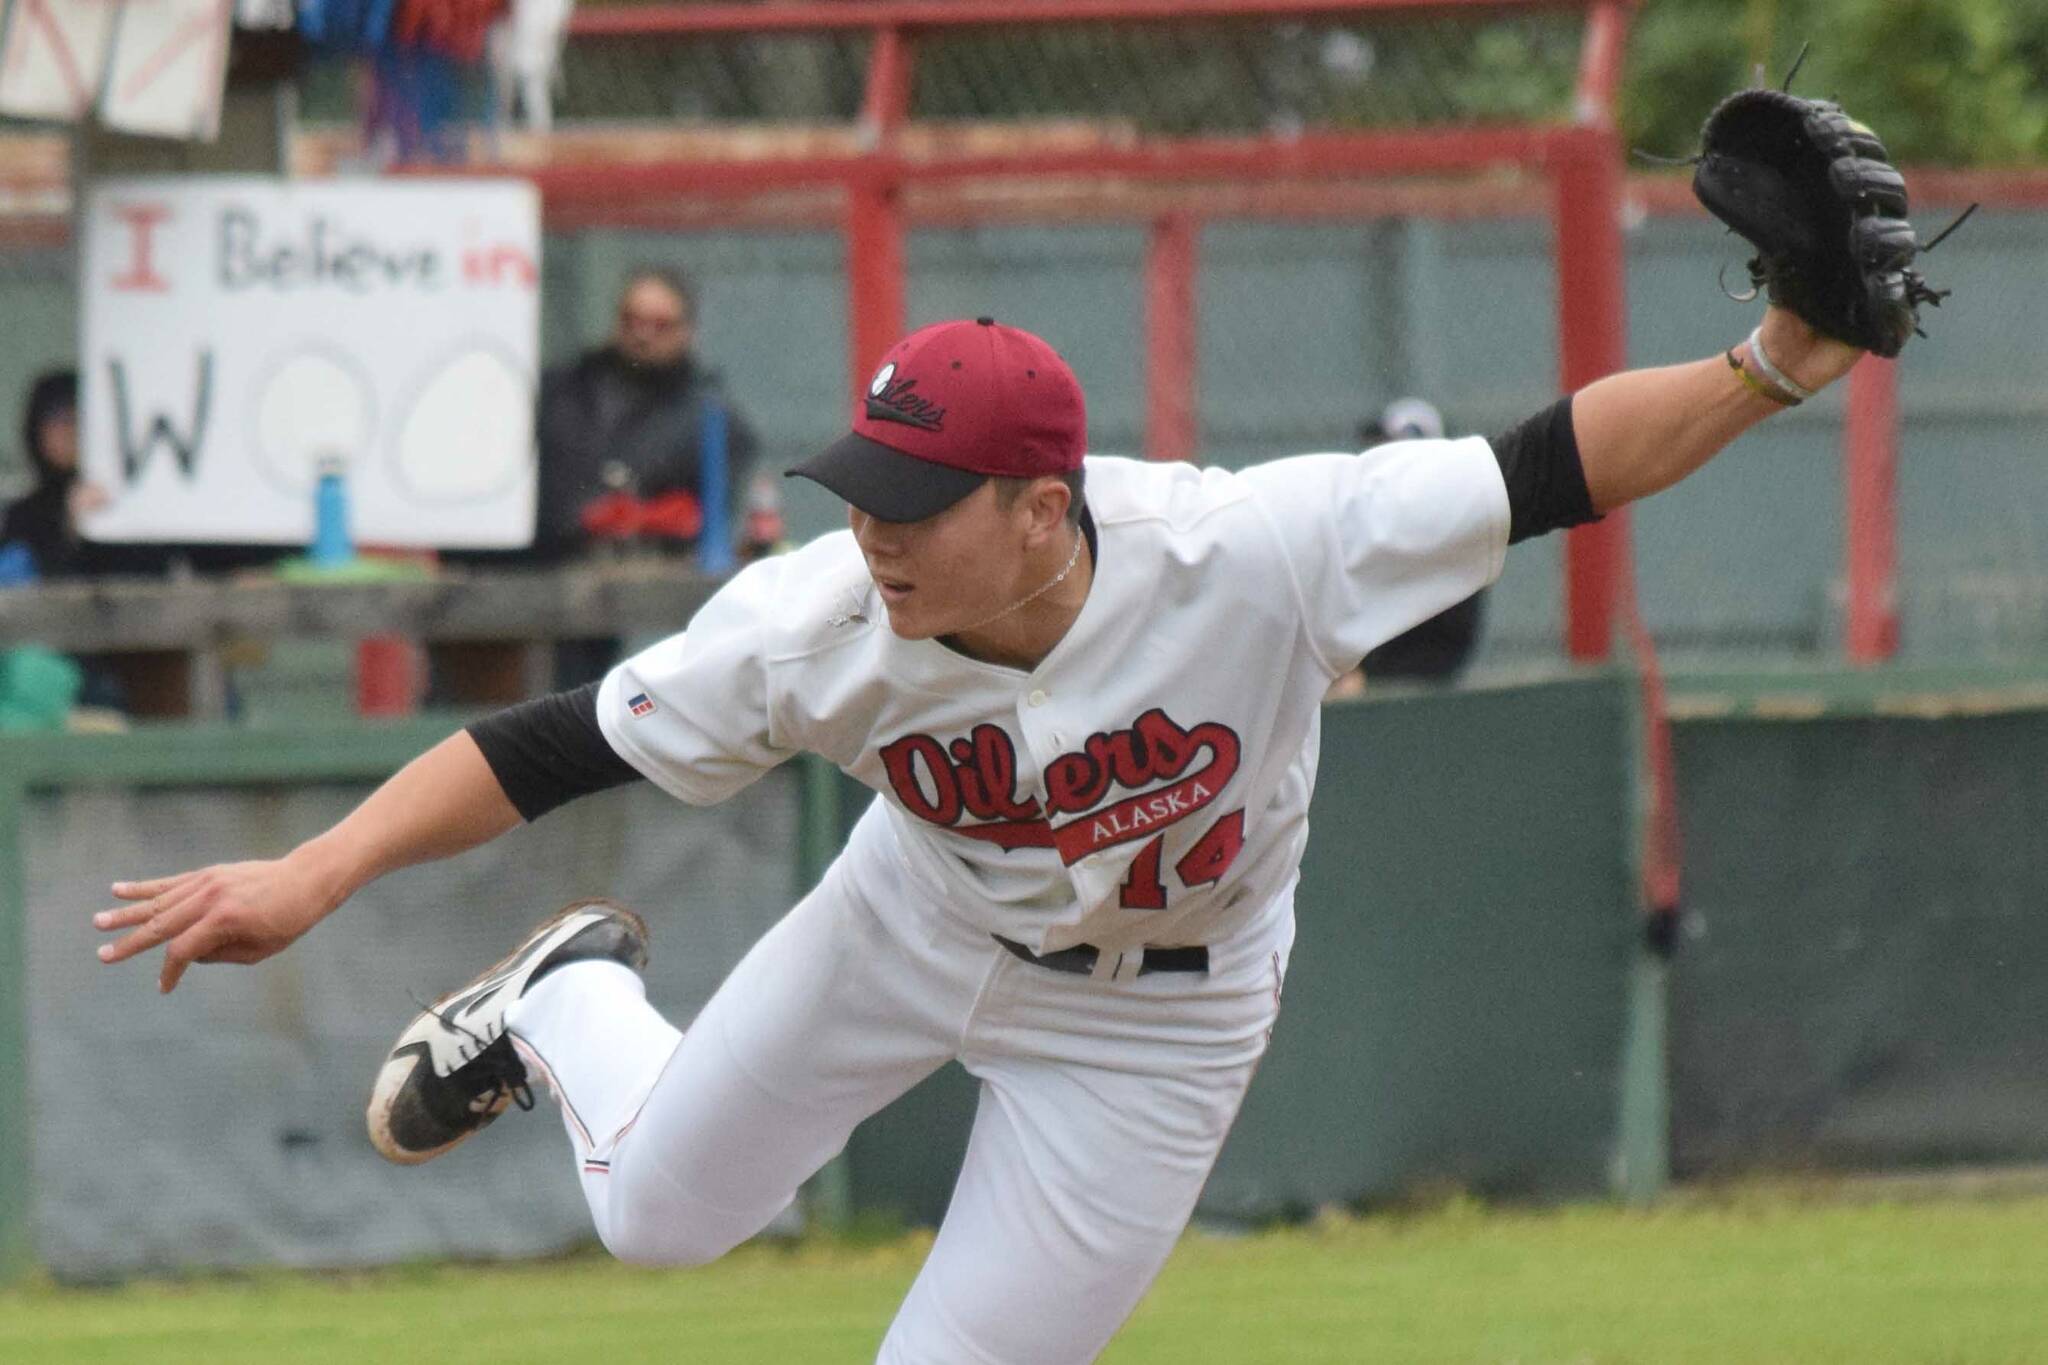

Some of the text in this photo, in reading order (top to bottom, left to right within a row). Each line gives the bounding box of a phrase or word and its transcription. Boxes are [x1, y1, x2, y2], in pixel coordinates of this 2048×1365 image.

[110, 203, 538, 295] I Believe in
[878, 707, 1242, 828] Oilers
[1091, 780, 1211, 843] ALASKA
